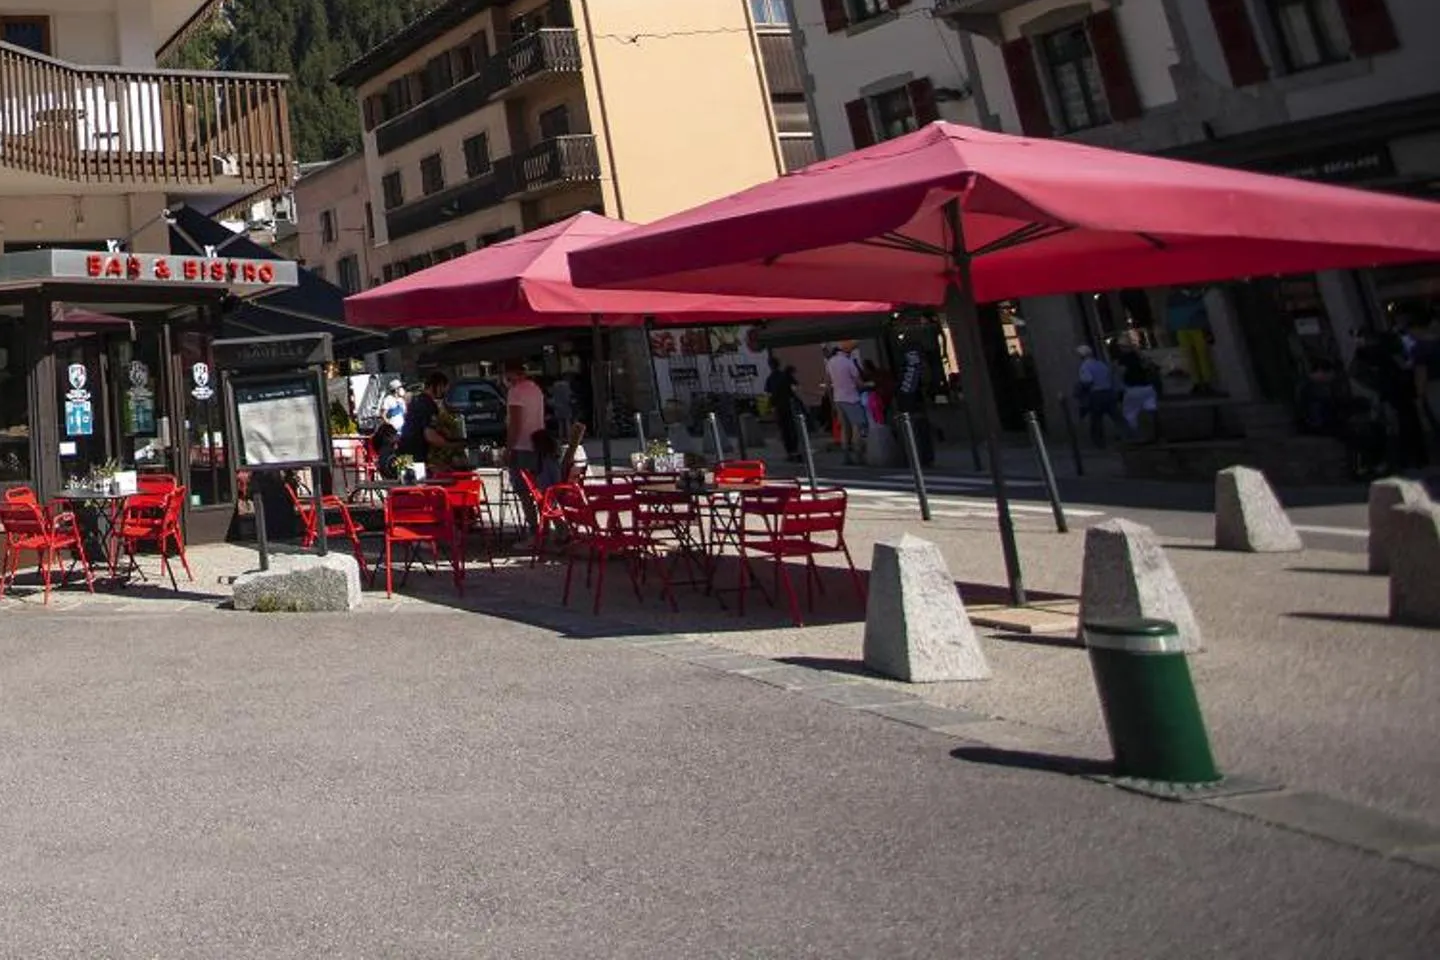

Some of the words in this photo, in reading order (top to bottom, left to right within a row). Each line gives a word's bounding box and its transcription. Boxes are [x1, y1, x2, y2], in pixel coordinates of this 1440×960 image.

[86, 254, 142, 280] BAR
[153, 256, 171, 280] &
[183, 258, 273, 283] BISTRO
